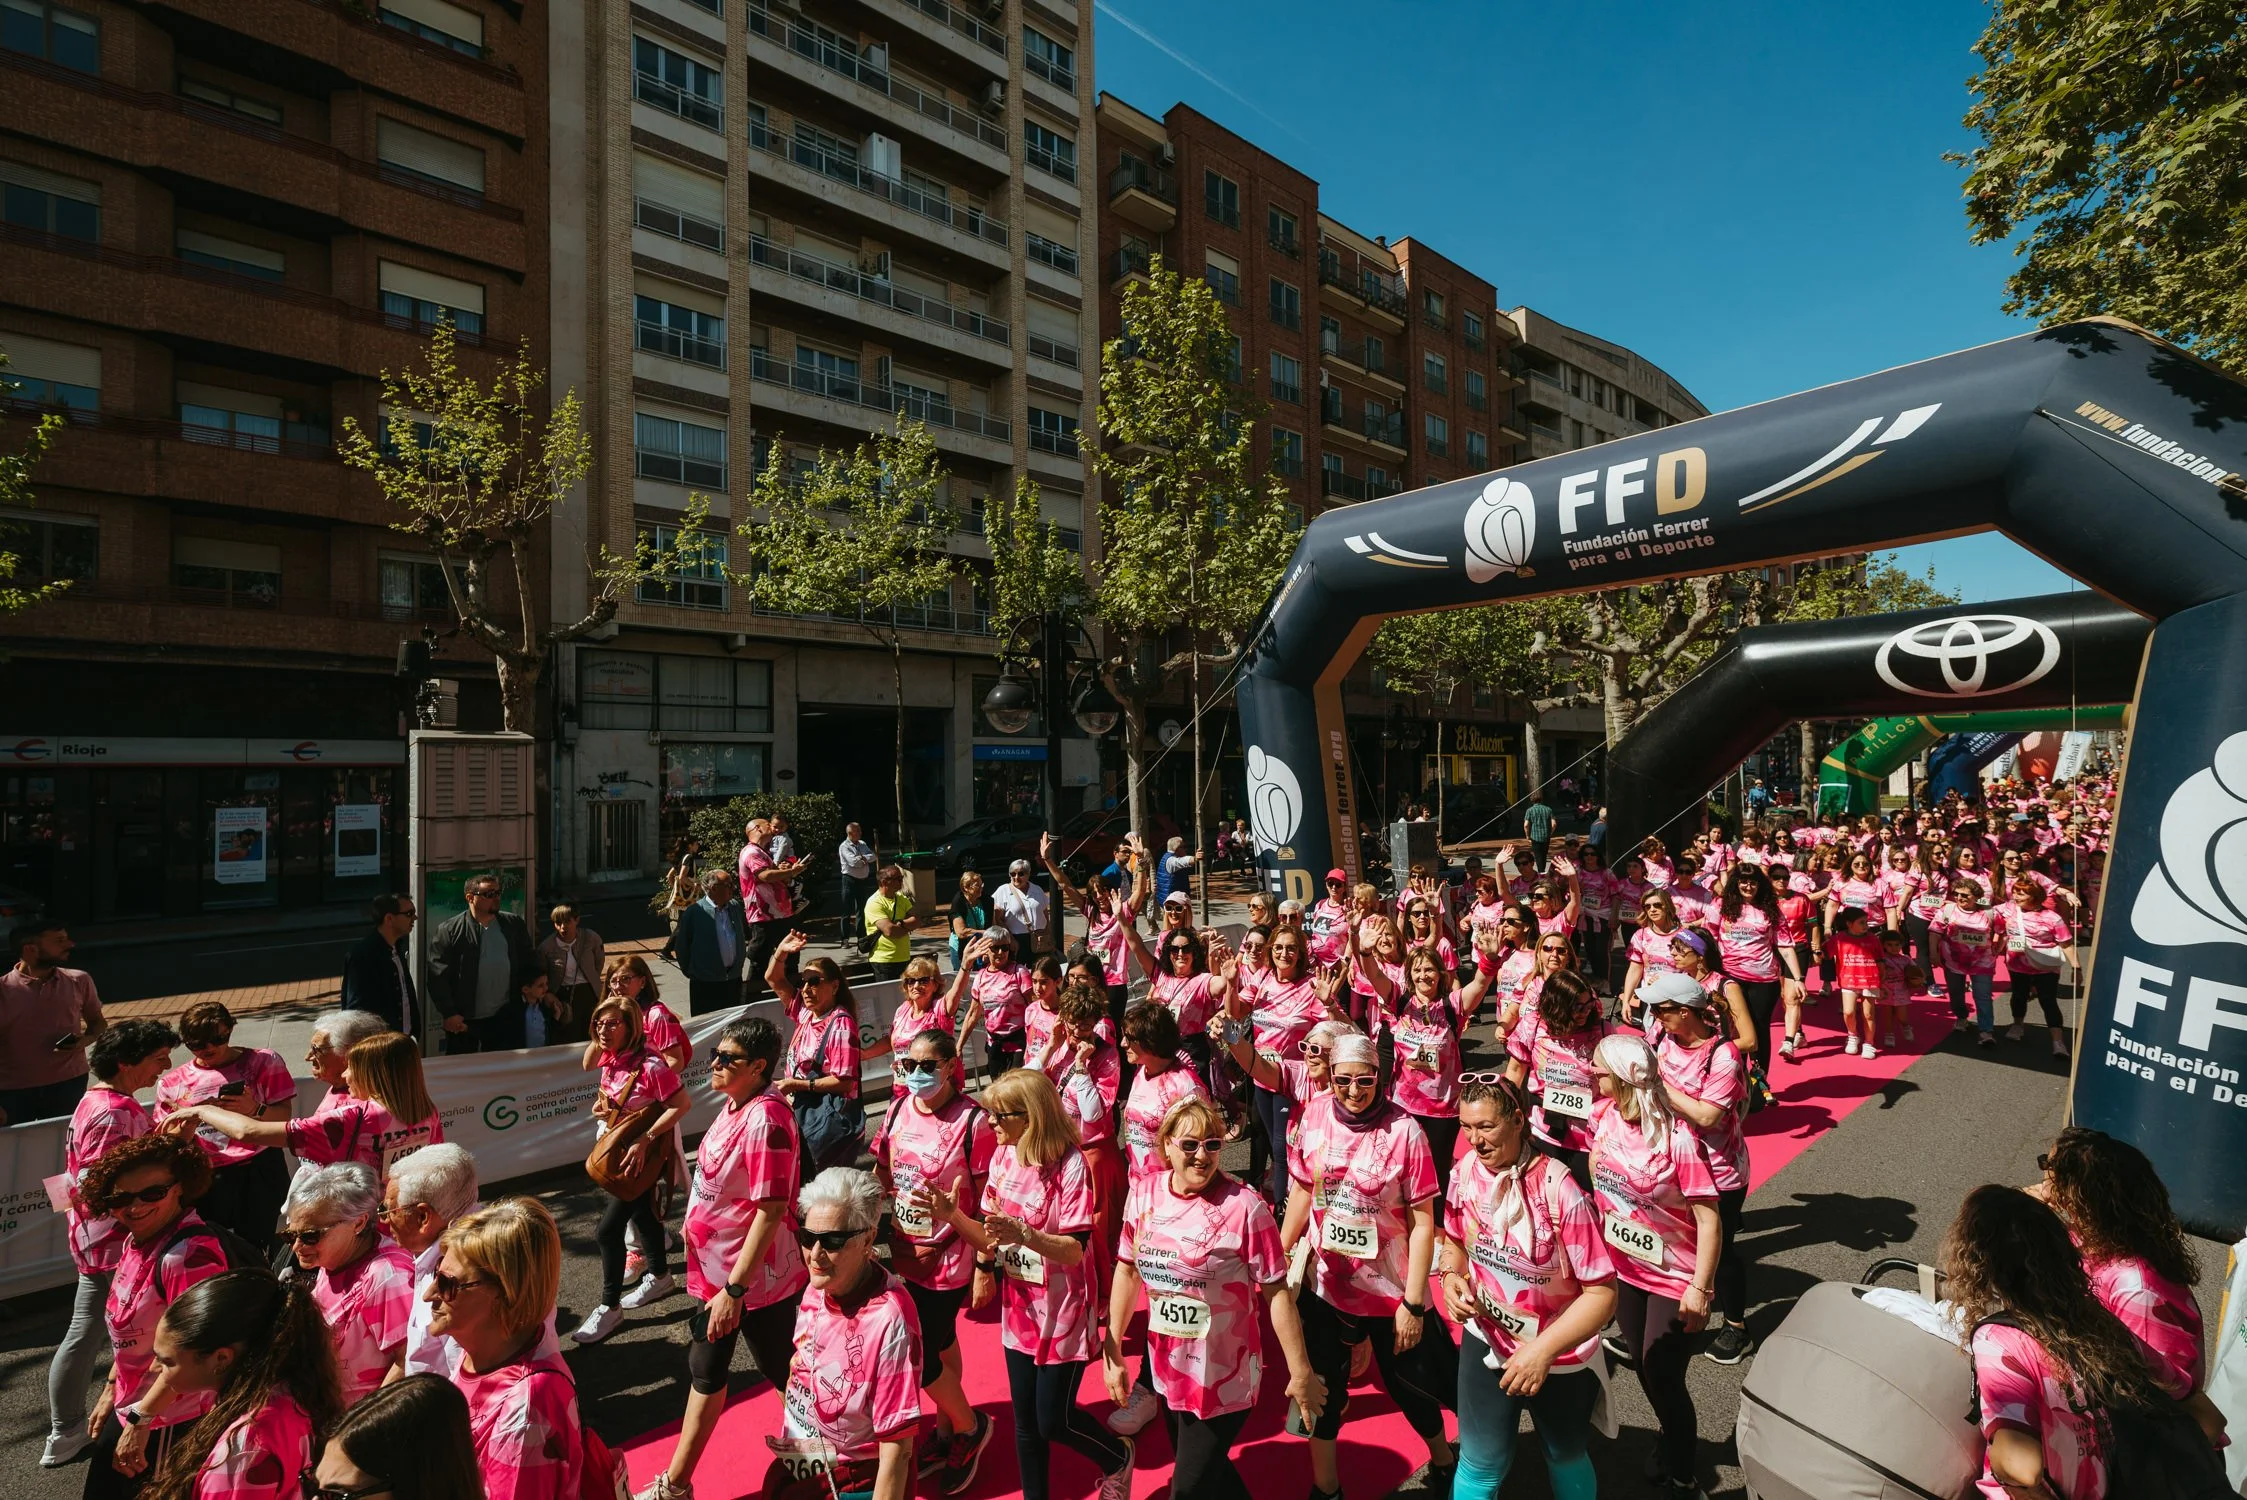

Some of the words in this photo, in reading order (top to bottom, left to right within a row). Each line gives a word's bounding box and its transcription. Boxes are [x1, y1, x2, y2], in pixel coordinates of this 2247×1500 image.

[1558, 446, 1707, 535] FFD
[1562, 528, 1649, 555] Fundación
[1653, 517, 1710, 538] Ferrer
[1568, 552, 1607, 571] para
[1615, 547, 1632, 561] el
[1639, 535, 1715, 557] Deporte
[1455, 724, 1468, 752] El
[62, 744, 107, 757] Rioja
[2062, 743, 2082, 776] aixaBank
[1546, 1057, 1576, 1070] Carrera
[2109, 1028, 2240, 1084] Fundación
[1545, 1074, 1593, 1089] Investigació
[1559, 1068, 1567, 1076] la
[2105, 1050, 2156, 1081] para
[2169, 1075, 2197, 1094] el
[687, 1079, 707, 1089] Rioja
[526, 1087, 576, 1103] asociación
[526, 1099, 557, 1112] contra
[559, 1097, 568, 1105] el
[570, 1091, 598, 1104] cánce
[1551, 1091, 1584, 1110] 2788
[438, 1104, 475, 1121] pañola
[526, 1113, 538, 1122] en
[541, 1110, 552, 1119] La
[555, 1105, 578, 1116] Rioja
[893, 1159, 919, 1173] Carrera
[1324, 1163, 1335, 1174] XI
[1595, 1161, 1627, 1183] Carrera
[895, 1202, 922, 1226] 2262
[1325, 1197, 1382, 1216] Investigación
[1143, 1231, 1153, 1241] XI
[1329, 1223, 1368, 1247] 3955
[1611, 1222, 1654, 1251] 4648
[1004, 1249, 1031, 1270] 484
[1138, 1243, 1178, 1260] Carrera
[1475, 1244, 1494, 1258] por
[1495, 1251, 1506, 1265] la
[1137, 1257, 1153, 1269] por
[1155, 1258, 1167, 1270] la
[1477, 1254, 1551, 1285] Investigación
[1140, 1269, 1207, 1289] Investigación
[1160, 1301, 1199, 1325] 4512
[1485, 1297, 1526, 1335] 3957
